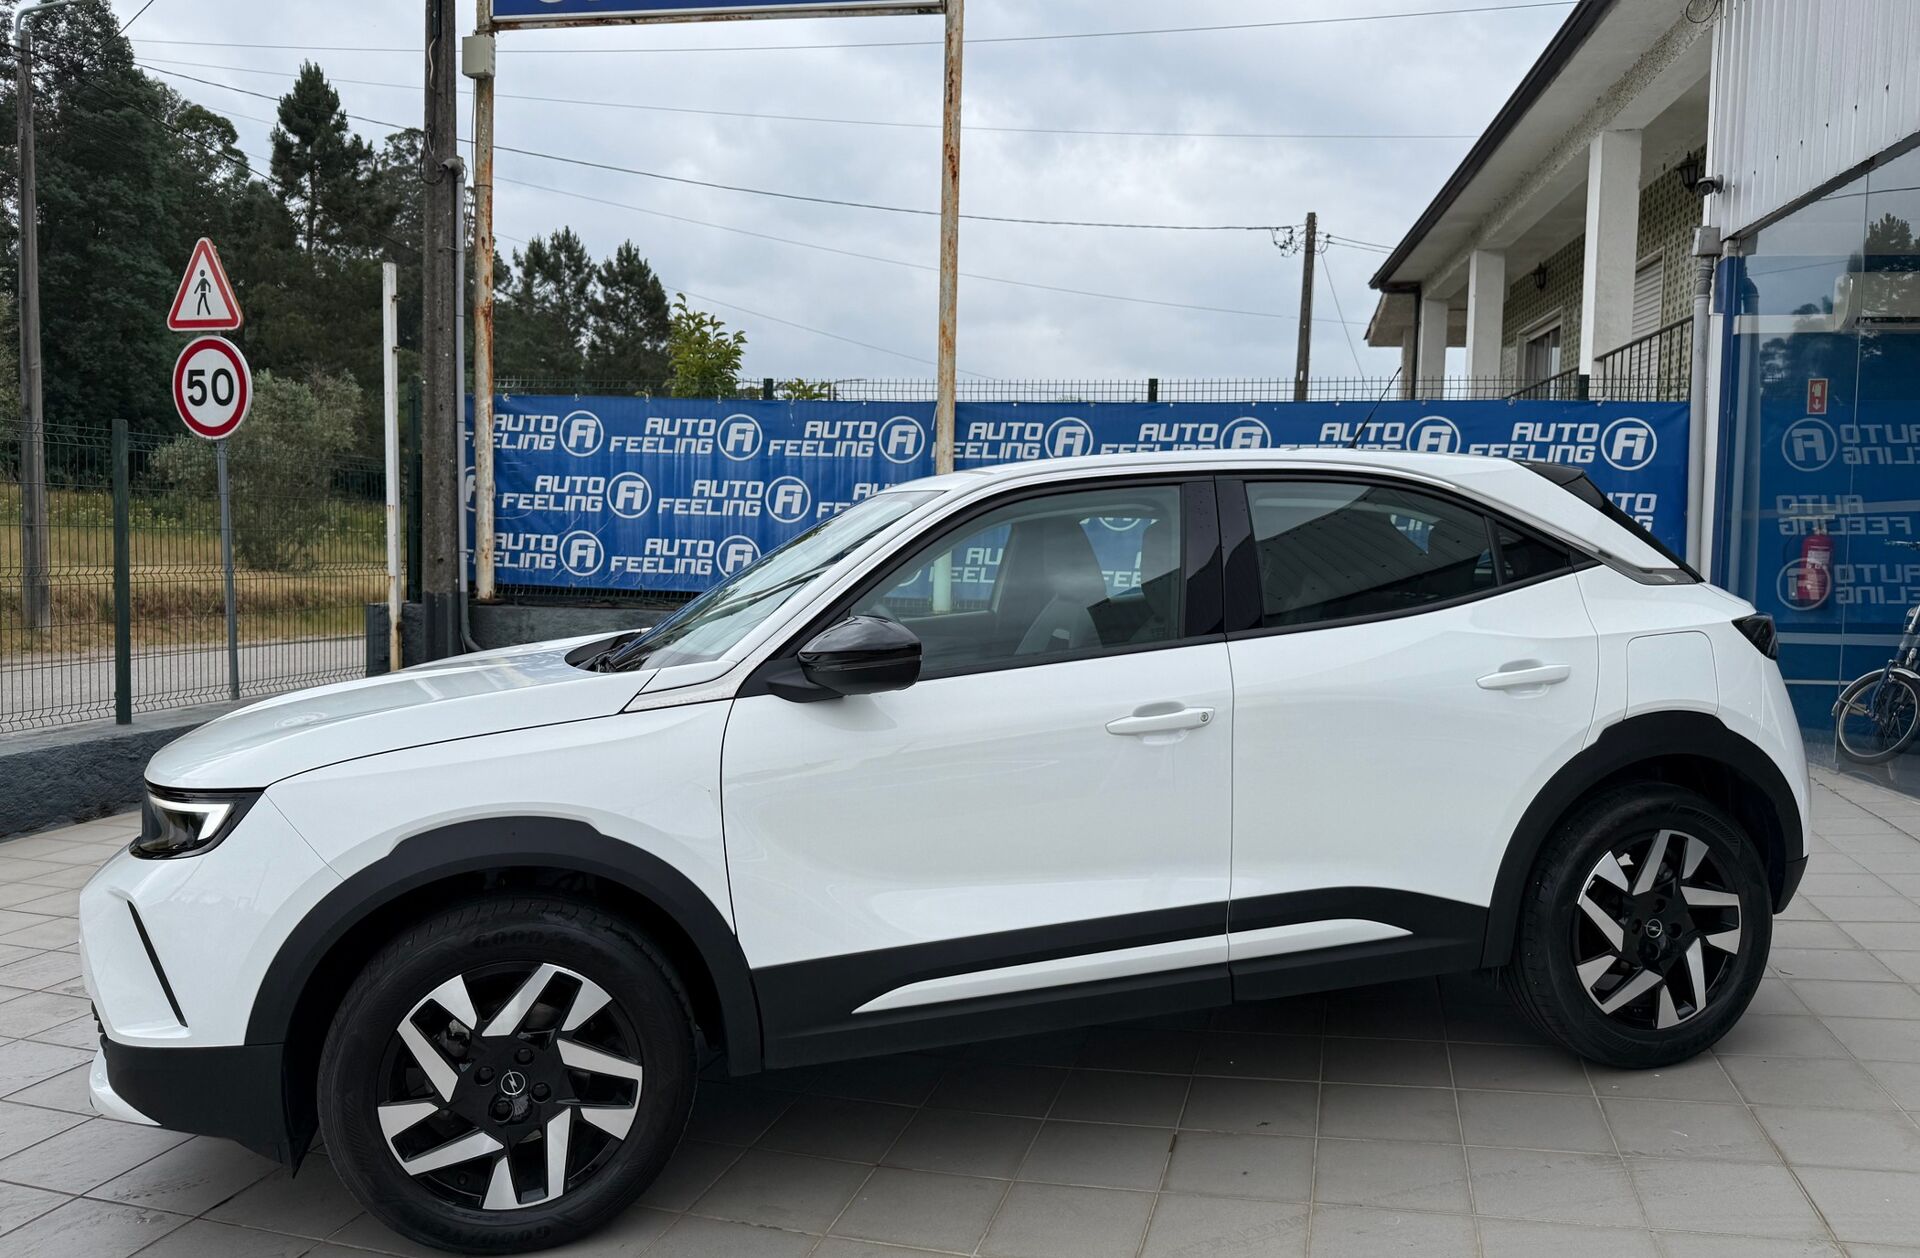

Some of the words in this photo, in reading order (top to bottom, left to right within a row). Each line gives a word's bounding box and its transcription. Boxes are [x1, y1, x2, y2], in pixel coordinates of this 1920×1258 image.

[187, 368, 234, 407] 50
[493, 415, 558, 432] AUTO
[645, 418, 716, 436] AUTO
[805, 421, 877, 438] AUTO
[968, 423, 1043, 440] AUTO
[1139, 424, 1218, 441] AUTO
[1320, 423, 1404, 441] AUTO
[1512, 423, 1599, 442] AUTO
[465, 431, 557, 451] ELING
[610, 437, 713, 454] FEELING
[768, 440, 874, 457] FEELING
[1467, 443, 1598, 463] FEELING
[536, 476, 605, 493] AUTO
[693, 480, 763, 498] AUTO
[503, 493, 603, 511] FEELING
[658, 498, 761, 516] FEELING
[1607, 493, 1657, 512] TO
[494, 533, 558, 551] AUTO
[645, 539, 714, 557] AUTO
[467, 549, 557, 569] ELING
[966, 548, 1003, 565] AU
[611, 557, 712, 575] FEELING
